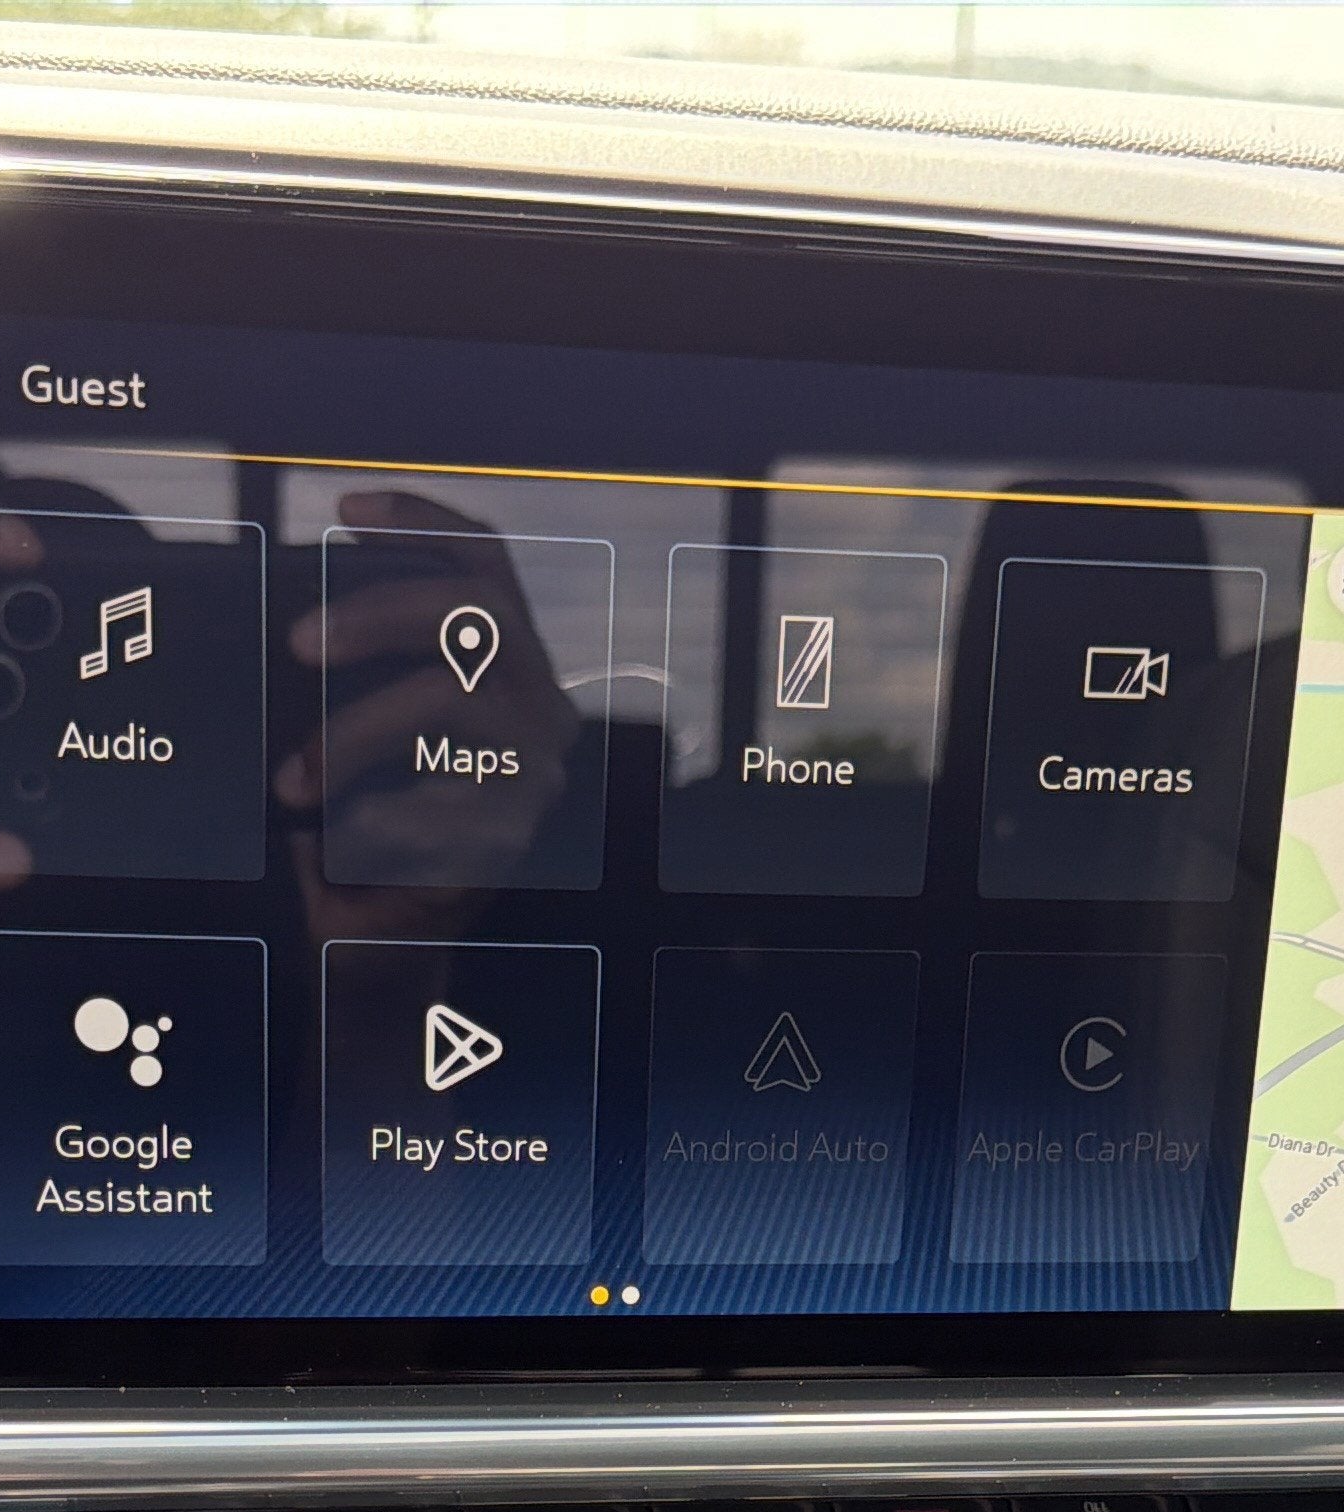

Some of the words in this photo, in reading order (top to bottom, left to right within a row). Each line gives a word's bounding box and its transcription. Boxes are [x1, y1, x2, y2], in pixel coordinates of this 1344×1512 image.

[20, 364, 147, 410] Guest
[57, 721, 174, 763] Audio
[414, 736, 521, 783] Maps
[742, 747, 855, 787] Phone
[1038, 756, 1194, 795] Cameras
[54, 1123, 194, 1170] Google
[370, 1129, 444, 1172] Play
[453, 1129, 550, 1165] Store
[662, 1130, 800, 1163] Android
[807, 1131, 891, 1163] Auto
[966, 1131, 1064, 1171] Apple
[1074, 1131, 1201, 1172] CarPlay
[1268, 1132, 1312, 1154] Diana
[1316, 1140, 1337, 1158] Dr
[35, 1178, 214, 1215] Assistant
[1290, 1172, 1341, 1218] Beauty
